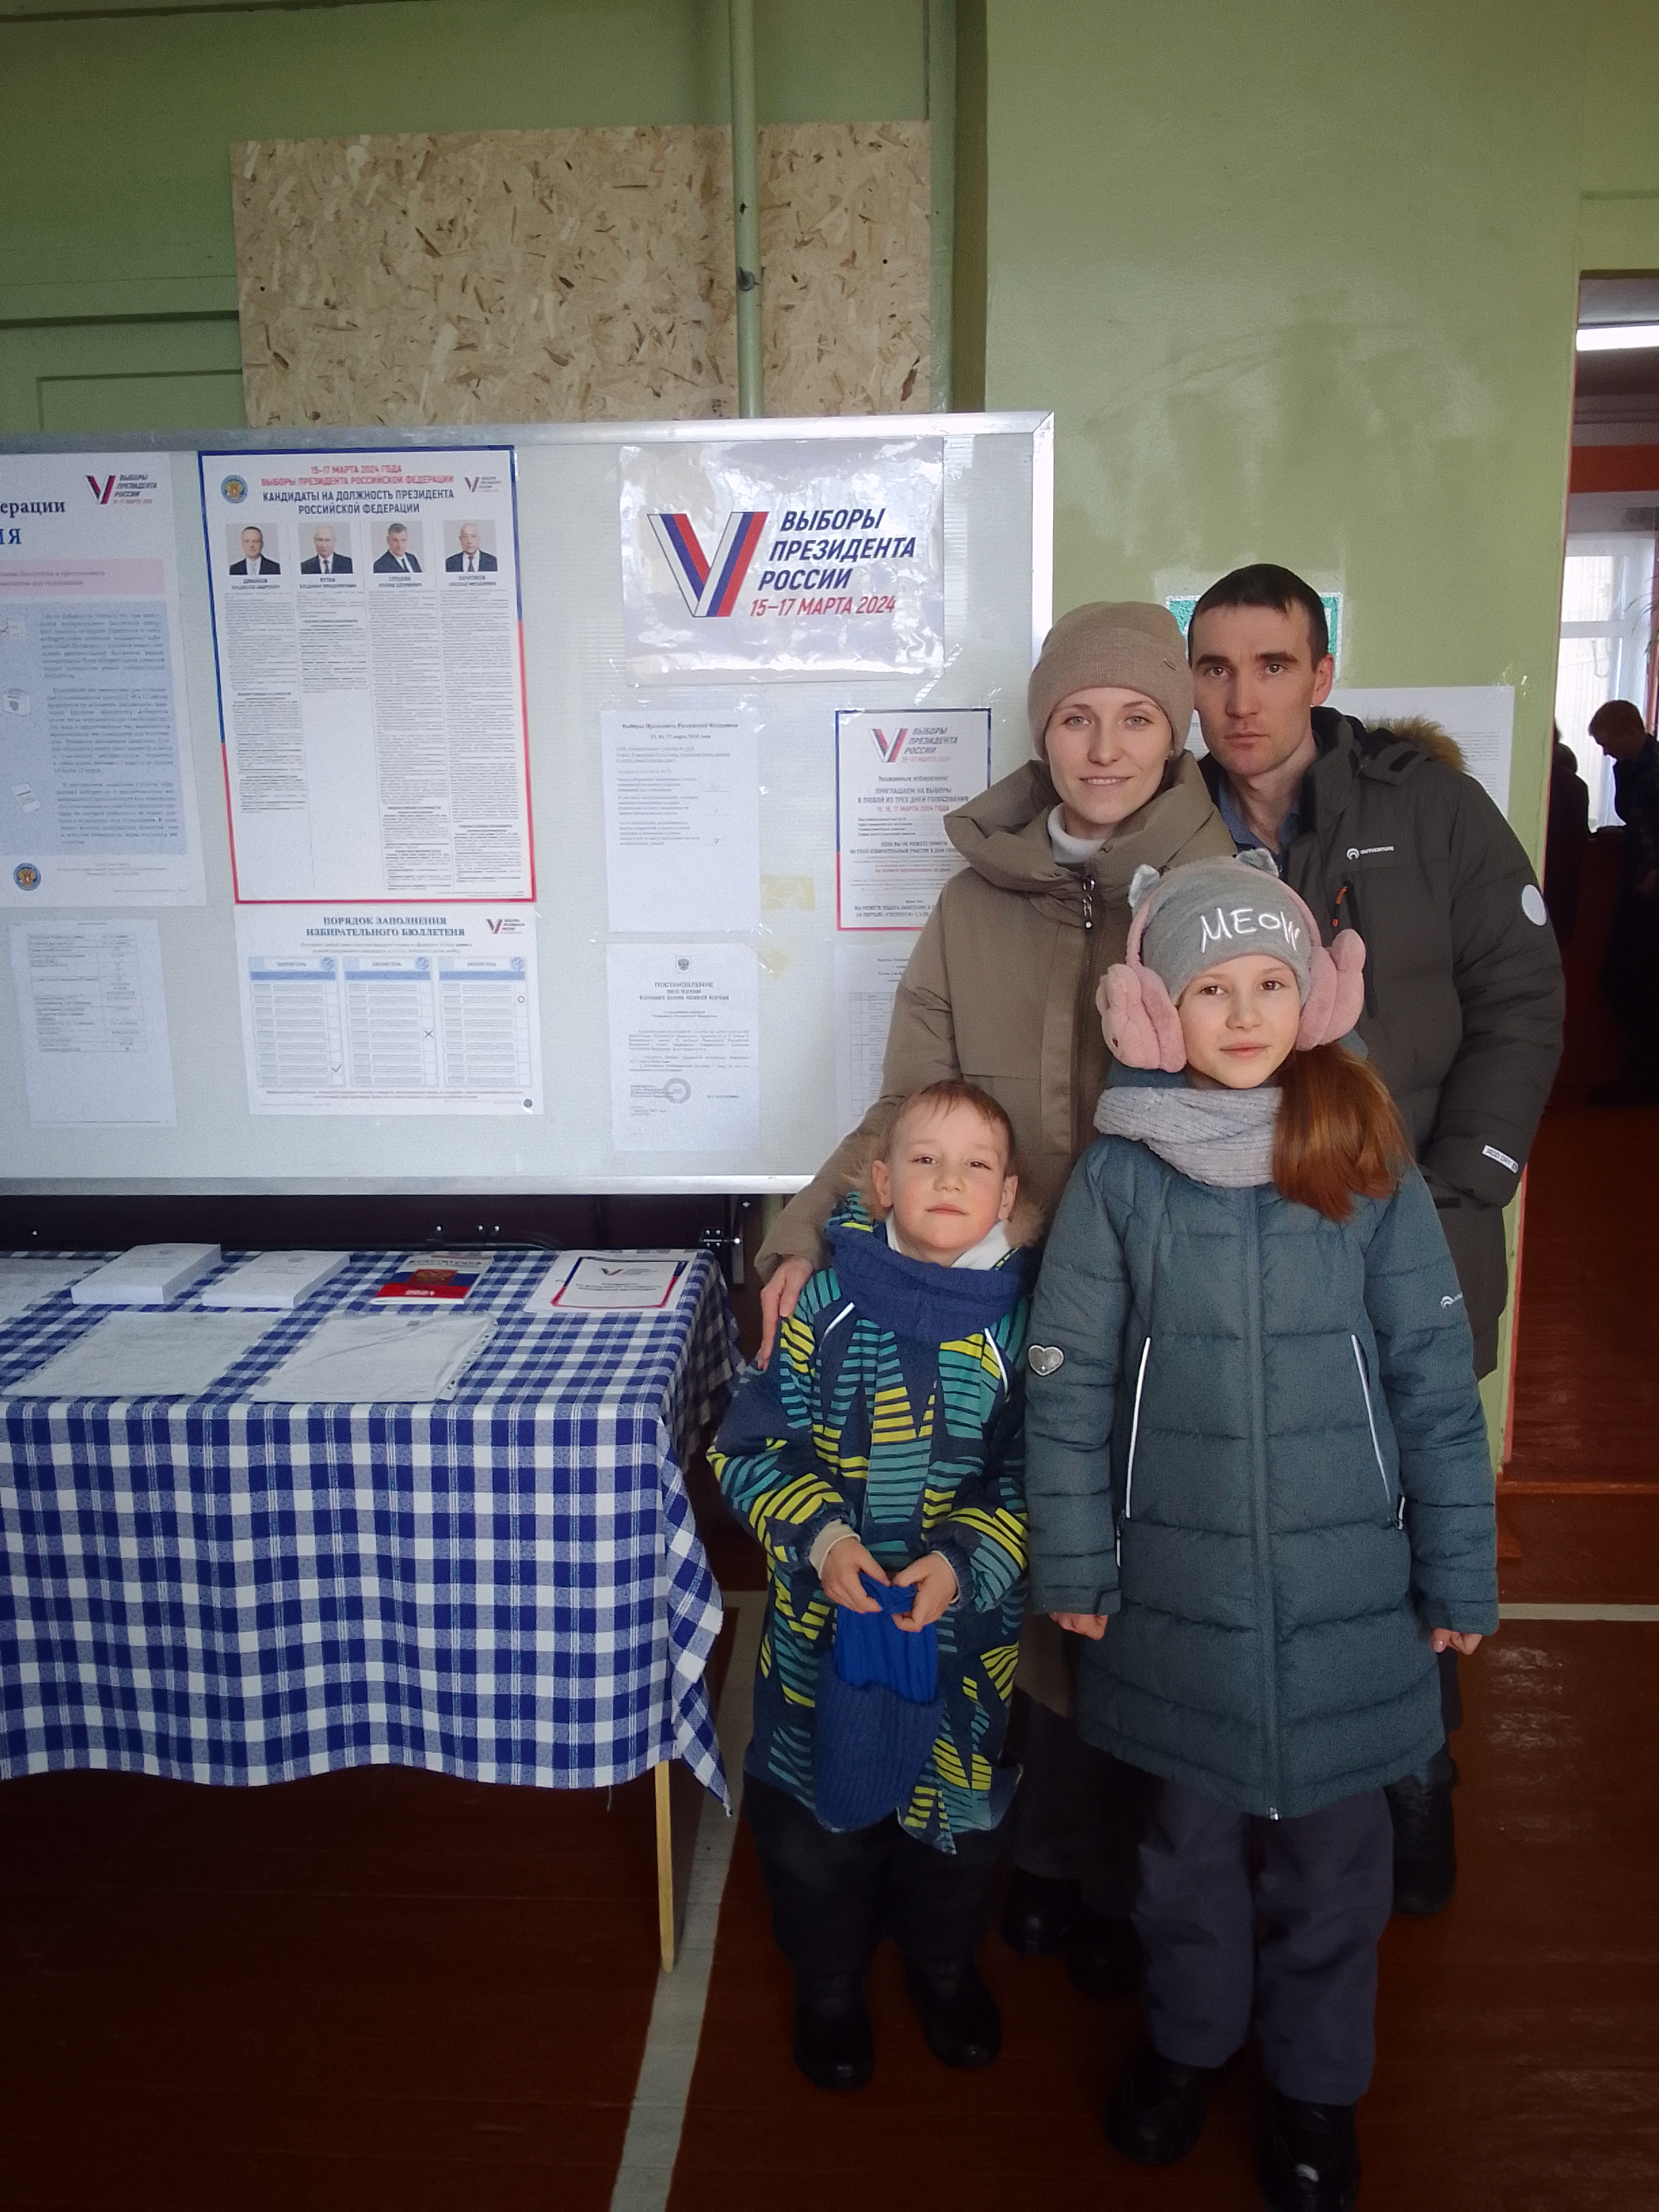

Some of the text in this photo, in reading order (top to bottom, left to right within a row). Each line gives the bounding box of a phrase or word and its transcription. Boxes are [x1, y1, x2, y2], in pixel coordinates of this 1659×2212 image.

[298, 476, 348, 486] ПРЕЗИДЕНТА
[263, 489, 454, 502] КАНДИДАТЫ НА ДОЛЖНОСТЬ ПРЕЗИДЕНТА
[298, 502, 420, 514] РОССИЙСКОЙ ФЕДЕРАЦИИ
[780, 508, 885, 531] ВЫБОРЫ
[769, 537, 916, 562] ПРЕЗИДЕНТА
[758, 568, 853, 591] РОССИИ
[798, 596, 853, 616] МАРТА
[855, 595, 897, 614] 2024
[912, 727, 947, 735] ВЫБОРЫ
[908, 737, 958, 745] ПРЕЗИДЕНТА
[323, 916, 447, 925] ПОРЯДОК ЗАПОЛНЕНИЯ
[306, 928, 465, 937] ИЗБИРАТЕЛЬНОГО БЮЛЛЕТЕНЯ
[1200, 907, 1301, 954] MEOW
